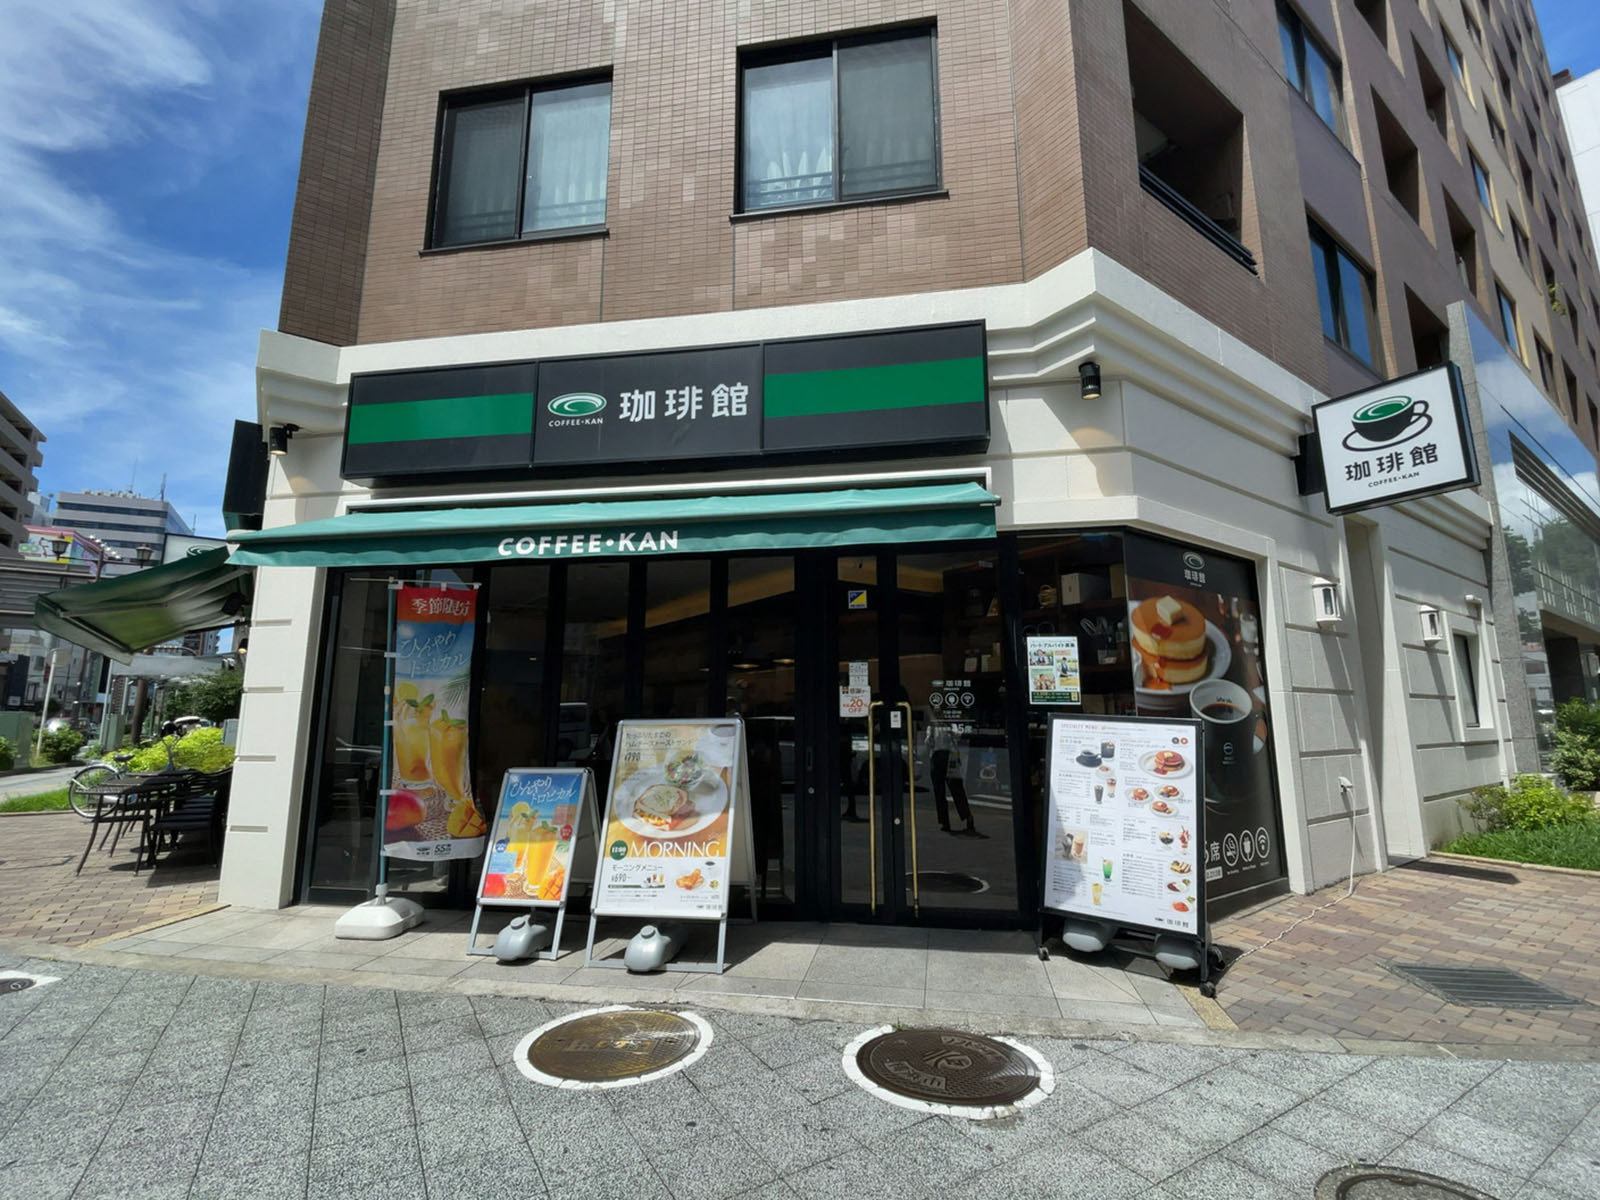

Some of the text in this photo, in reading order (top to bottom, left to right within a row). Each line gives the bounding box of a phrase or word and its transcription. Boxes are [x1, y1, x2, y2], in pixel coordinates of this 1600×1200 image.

[619, 382, 749, 423] 珈琲館
[1345, 443, 1438, 481] 珈琲館
[510, 775, 552, 798] ひんやり
[531, 787, 577, 804] トロピカル
[630, 841, 720, 858] MORNING
[612, 863, 664, 872] モーニングメニュー
